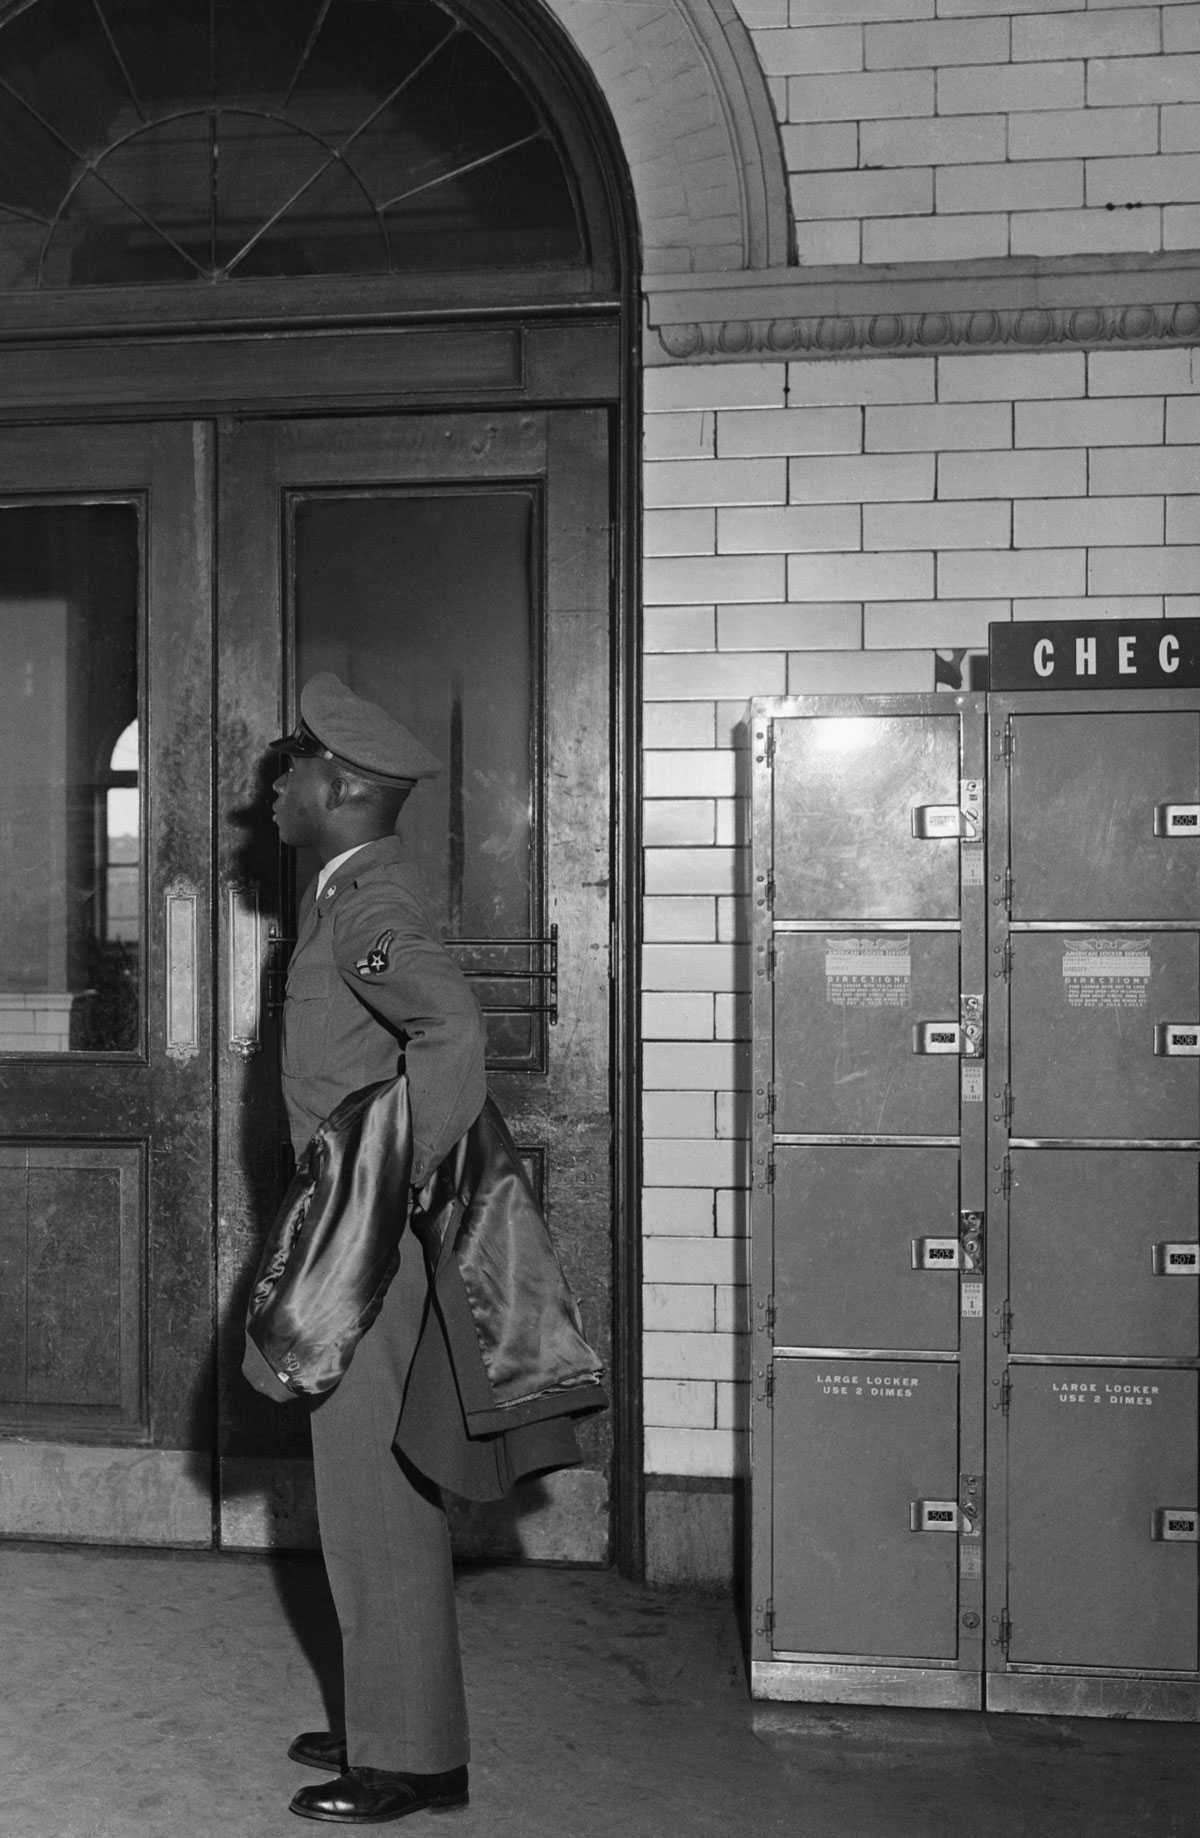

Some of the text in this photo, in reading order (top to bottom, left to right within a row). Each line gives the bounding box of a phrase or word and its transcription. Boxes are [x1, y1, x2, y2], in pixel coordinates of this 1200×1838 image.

[1032, 633, 1180, 677] CHEC
[1064, 977, 1149, 985] DIRECTIONS
[816, 1375, 920, 1386] LARGE LOCKER
[823, 1386, 913, 1398] USE 2 DIMES
[1052, 1383, 1159, 1394] LARGE LOCKER
[1059, 1393, 1153, 1406] USE 2 DIMES
